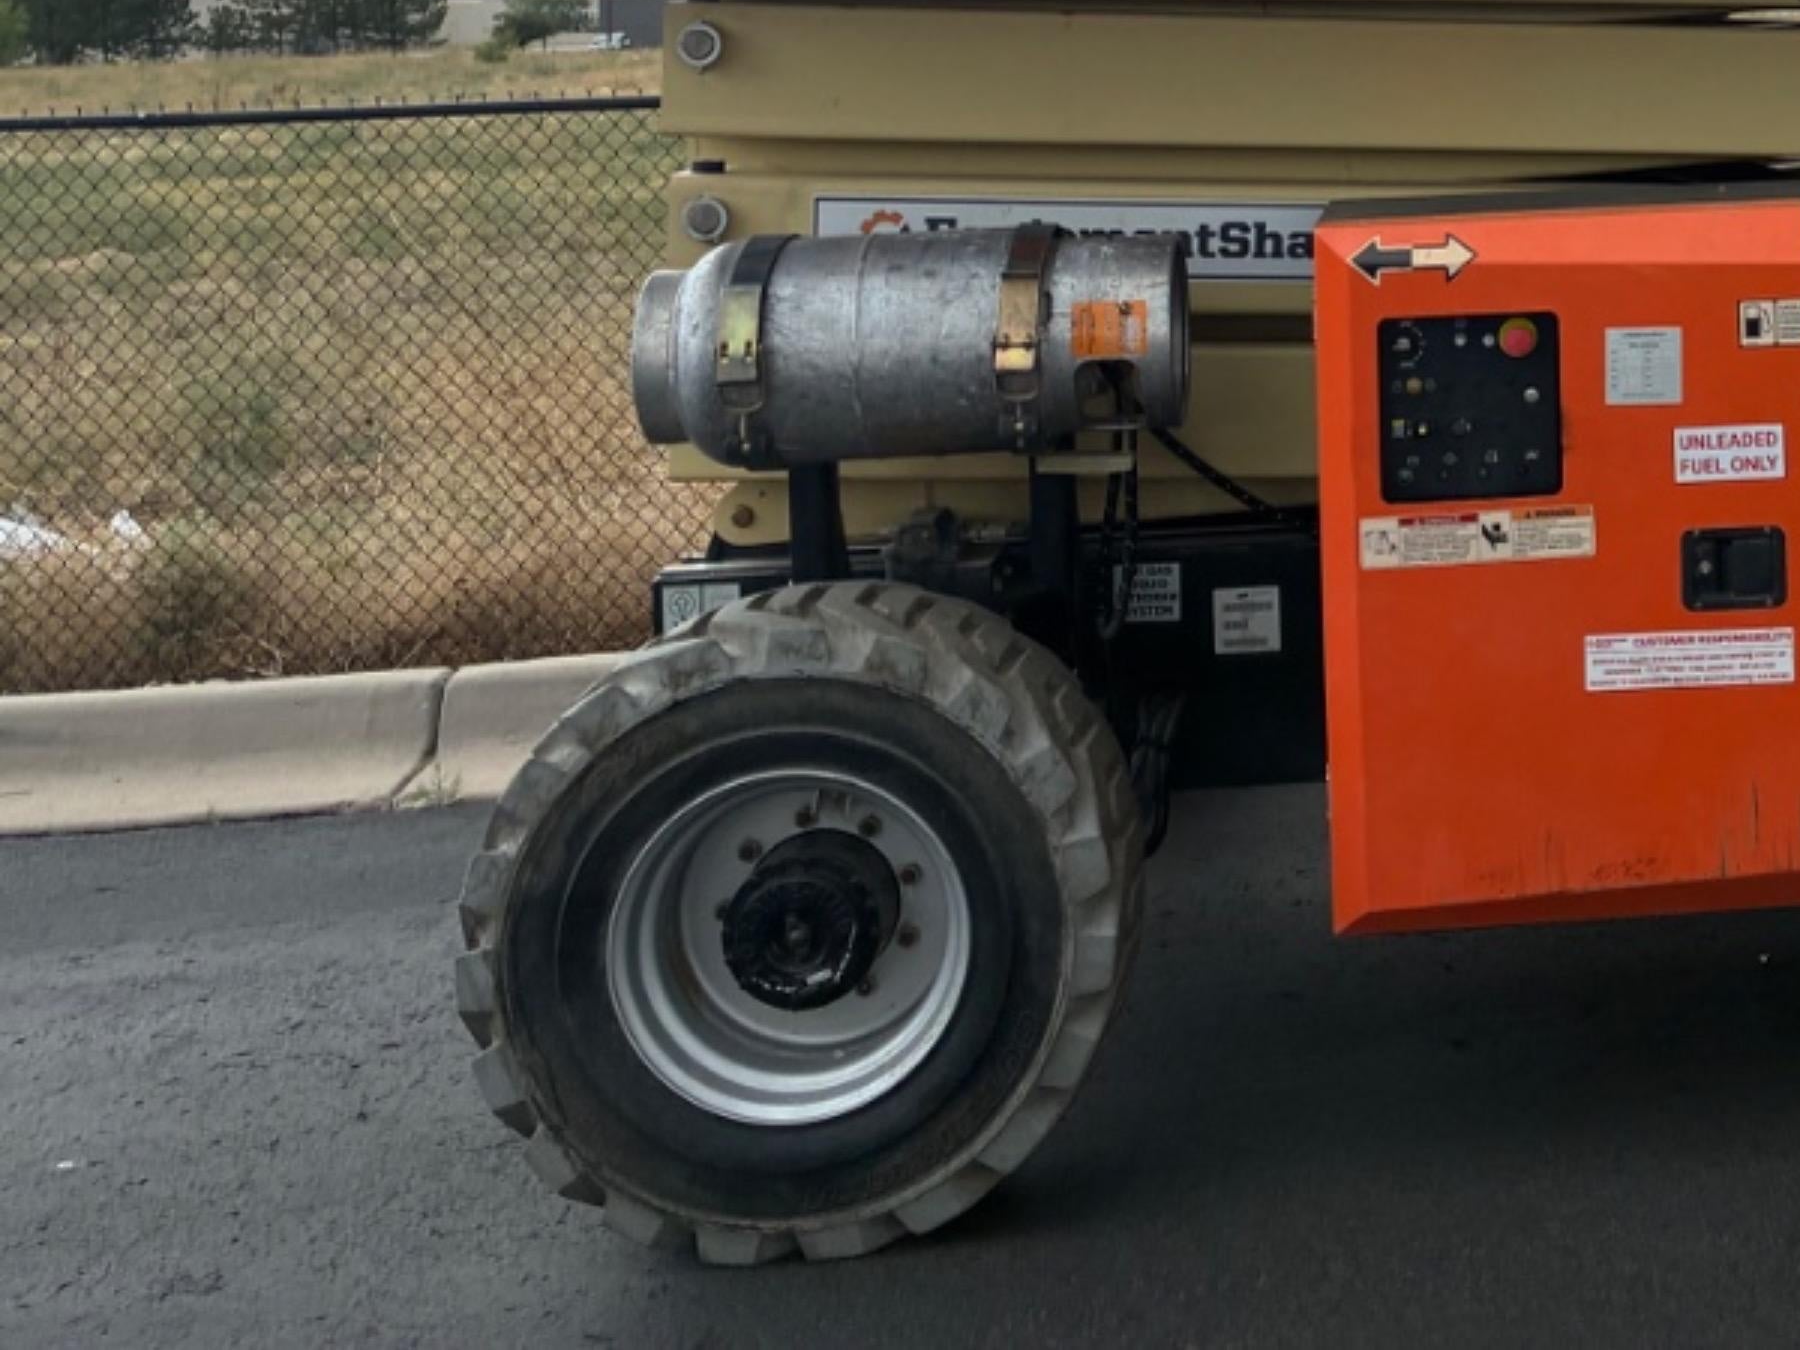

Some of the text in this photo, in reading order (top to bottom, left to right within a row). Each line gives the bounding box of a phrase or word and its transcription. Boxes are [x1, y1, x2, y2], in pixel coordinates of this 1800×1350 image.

[1680, 431, 1777, 450] UNLEADED
[1680, 454, 1779, 475] FUEL ONLY
